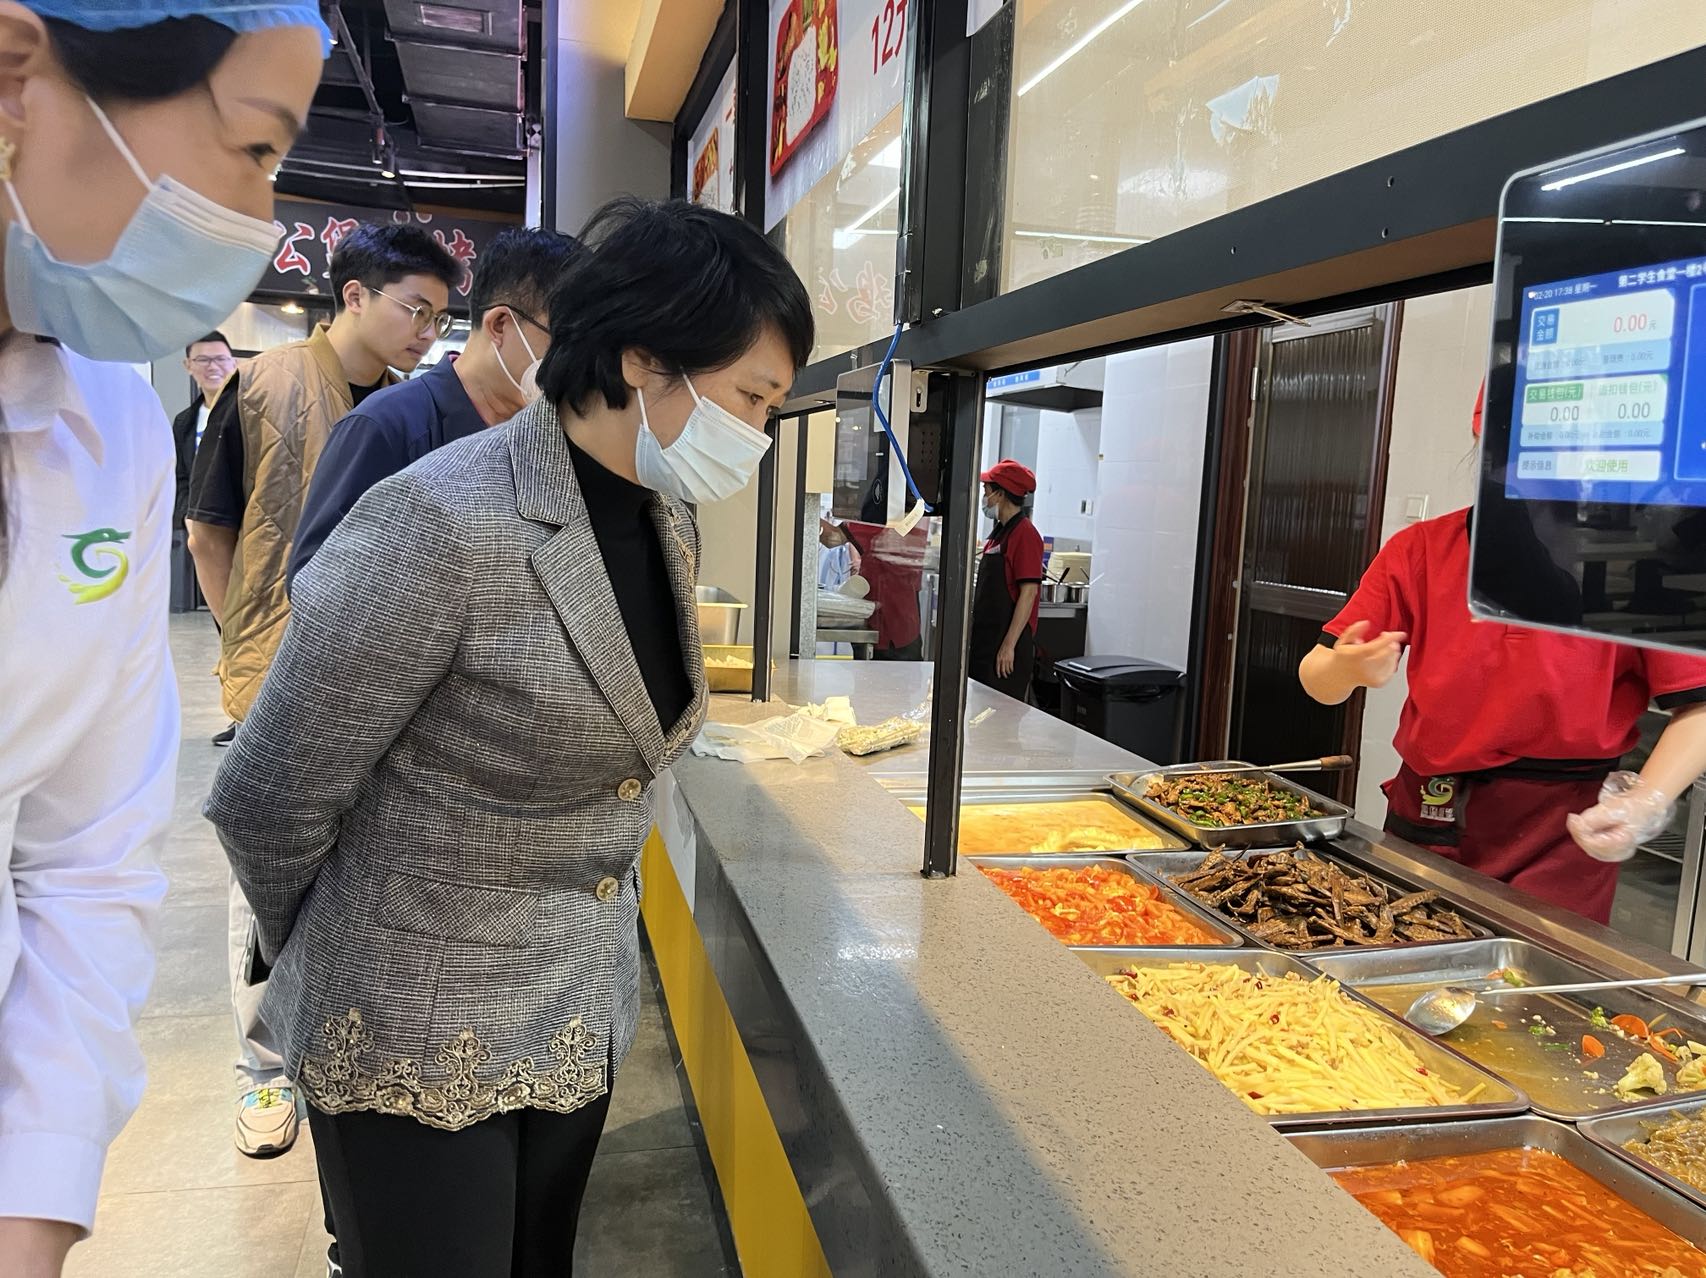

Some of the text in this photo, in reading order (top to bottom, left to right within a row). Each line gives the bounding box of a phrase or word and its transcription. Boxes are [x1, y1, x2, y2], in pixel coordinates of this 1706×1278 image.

[1613, 313, 1647, 333] 0.00
[1550, 405, 1580, 422] 0.00
[1617, 402, 1650, 420] 0.00
